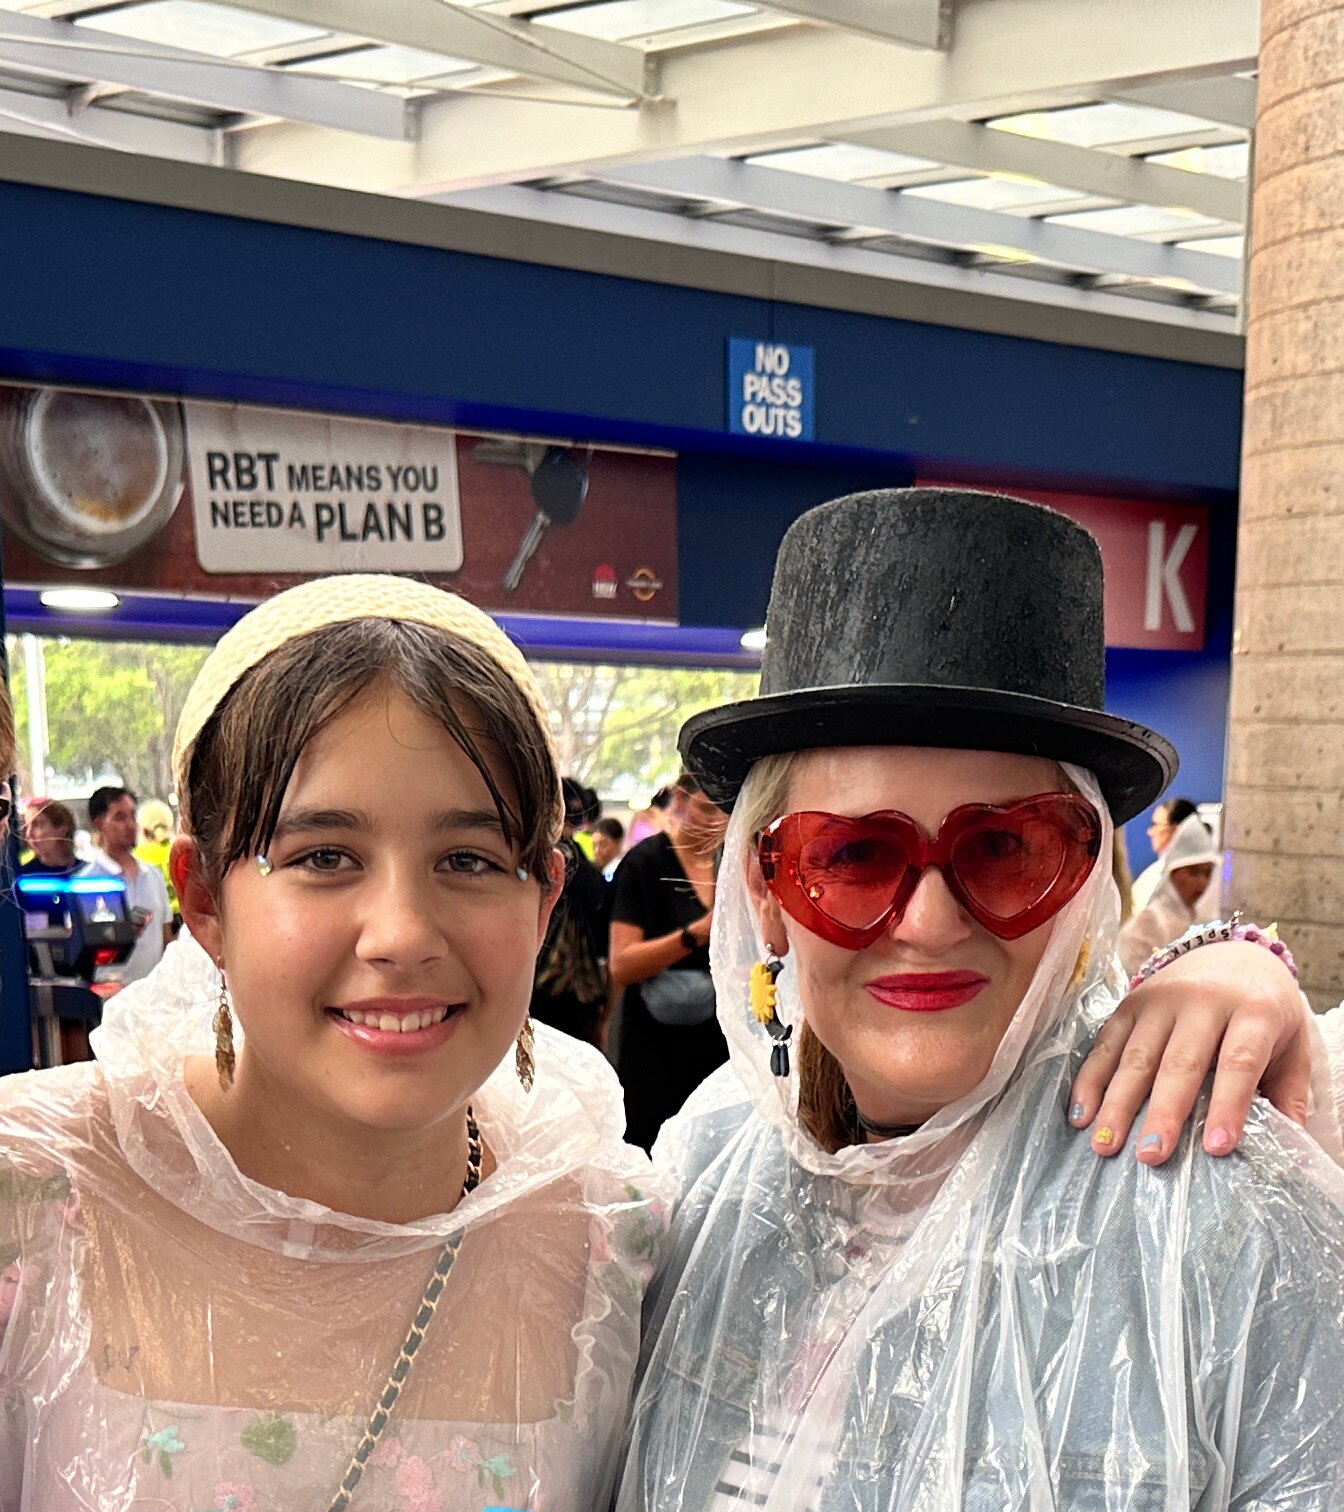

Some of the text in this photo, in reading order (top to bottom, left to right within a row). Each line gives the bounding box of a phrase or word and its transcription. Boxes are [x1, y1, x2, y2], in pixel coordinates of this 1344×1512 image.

[755, 344, 789, 375] NO
[743, 372, 802, 407] PASS
[741, 403, 802, 437] OUTS
[206, 452, 439, 492] RBT MEANS YOU
[210, 501, 446, 542] NEED A PLAN B
[1144, 520, 1197, 632] K
[1170, 928, 1230, 957] SPEAK
